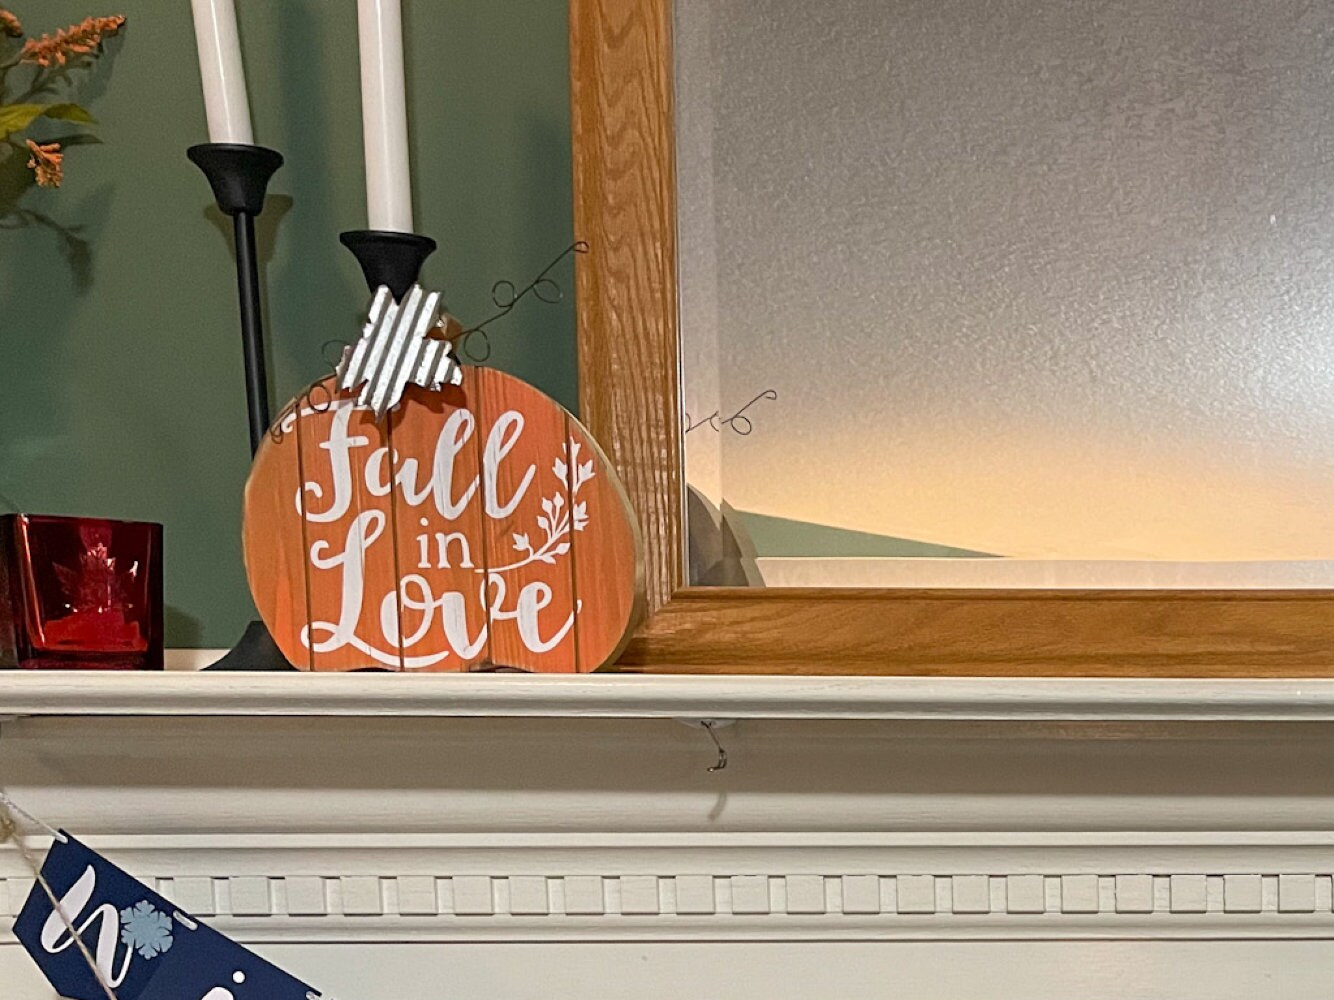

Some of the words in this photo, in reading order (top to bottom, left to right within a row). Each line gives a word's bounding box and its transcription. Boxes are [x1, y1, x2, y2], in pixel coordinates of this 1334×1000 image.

[281, 399, 536, 523] Fall
[300, 509, 583, 669] Love
[416, 517, 475, 570] in
